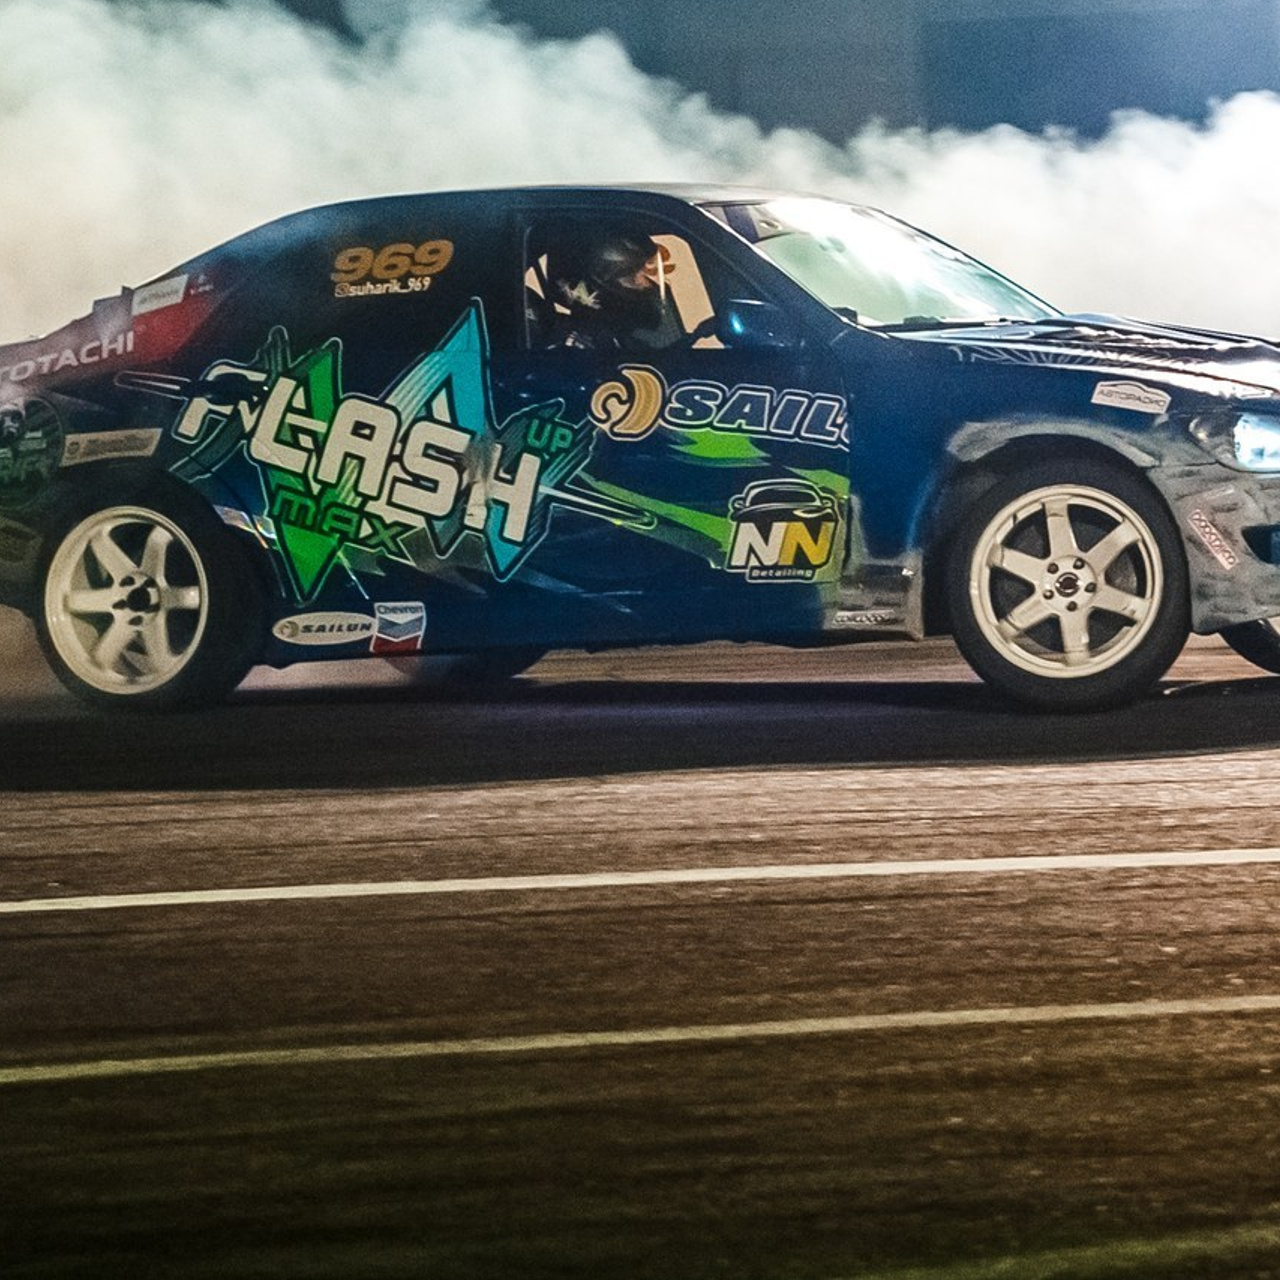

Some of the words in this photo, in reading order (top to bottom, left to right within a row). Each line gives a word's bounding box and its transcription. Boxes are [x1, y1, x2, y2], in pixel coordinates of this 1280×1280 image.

[330, 239, 455, 282] 969
[663, 384, 850, 444] SAIL
[526, 419, 574, 452] UP
[730, 521, 836, 567] NN
[301, 622, 373, 634] SAILUN
[376, 604, 423, 615] Chevron
